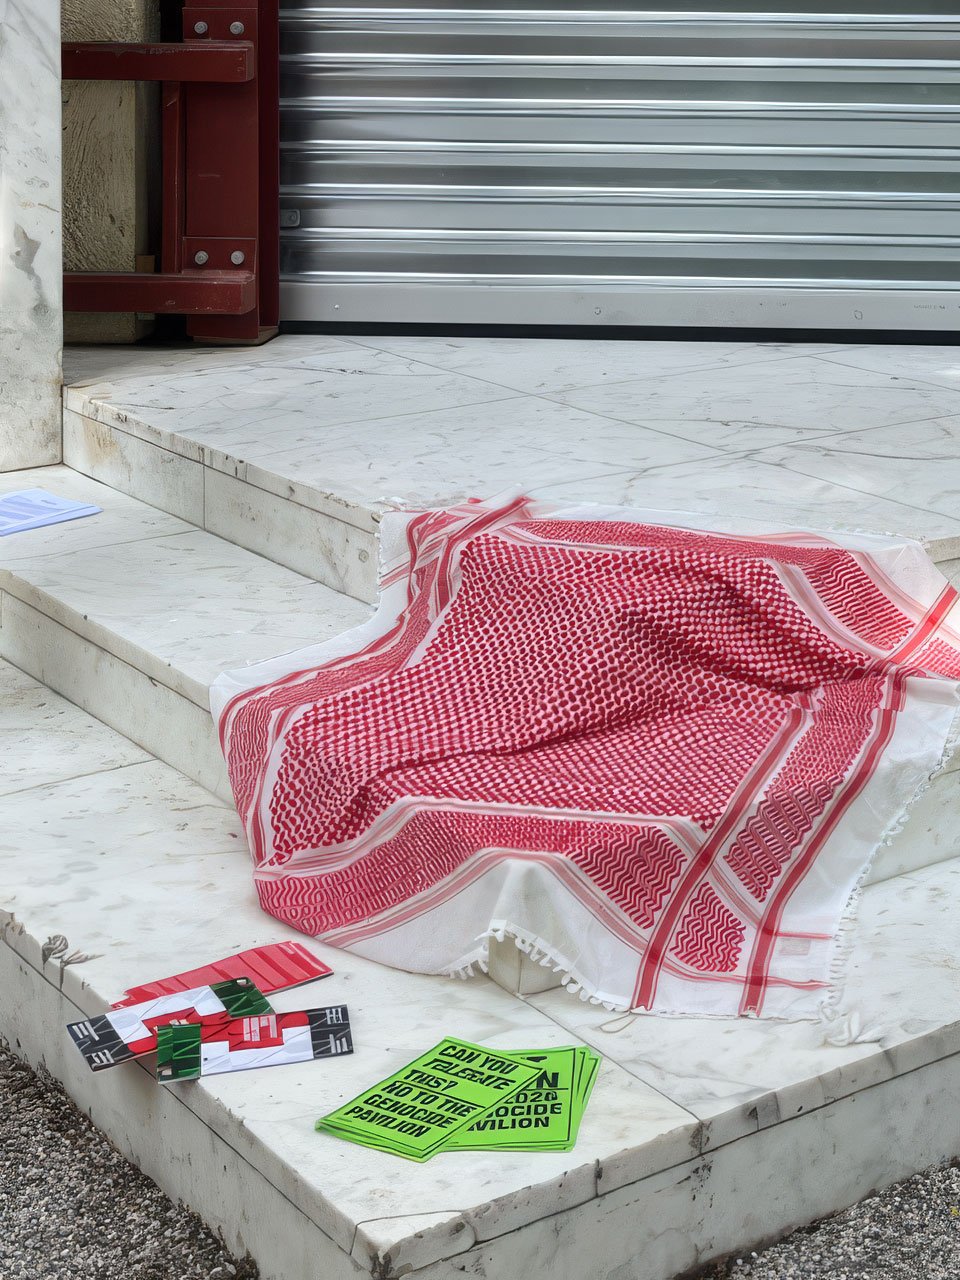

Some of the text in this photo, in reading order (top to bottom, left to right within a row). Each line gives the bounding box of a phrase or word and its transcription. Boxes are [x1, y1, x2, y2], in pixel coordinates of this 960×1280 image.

[438, 1045, 519, 1074] CAN YOU
[363, 1094, 458, 1128] GENOCIDE
[381, 1081, 477, 1117] NO TO THE
[486, 1103, 562, 1118] OCIDE
[344, 1106, 431, 1137] PAVILION
